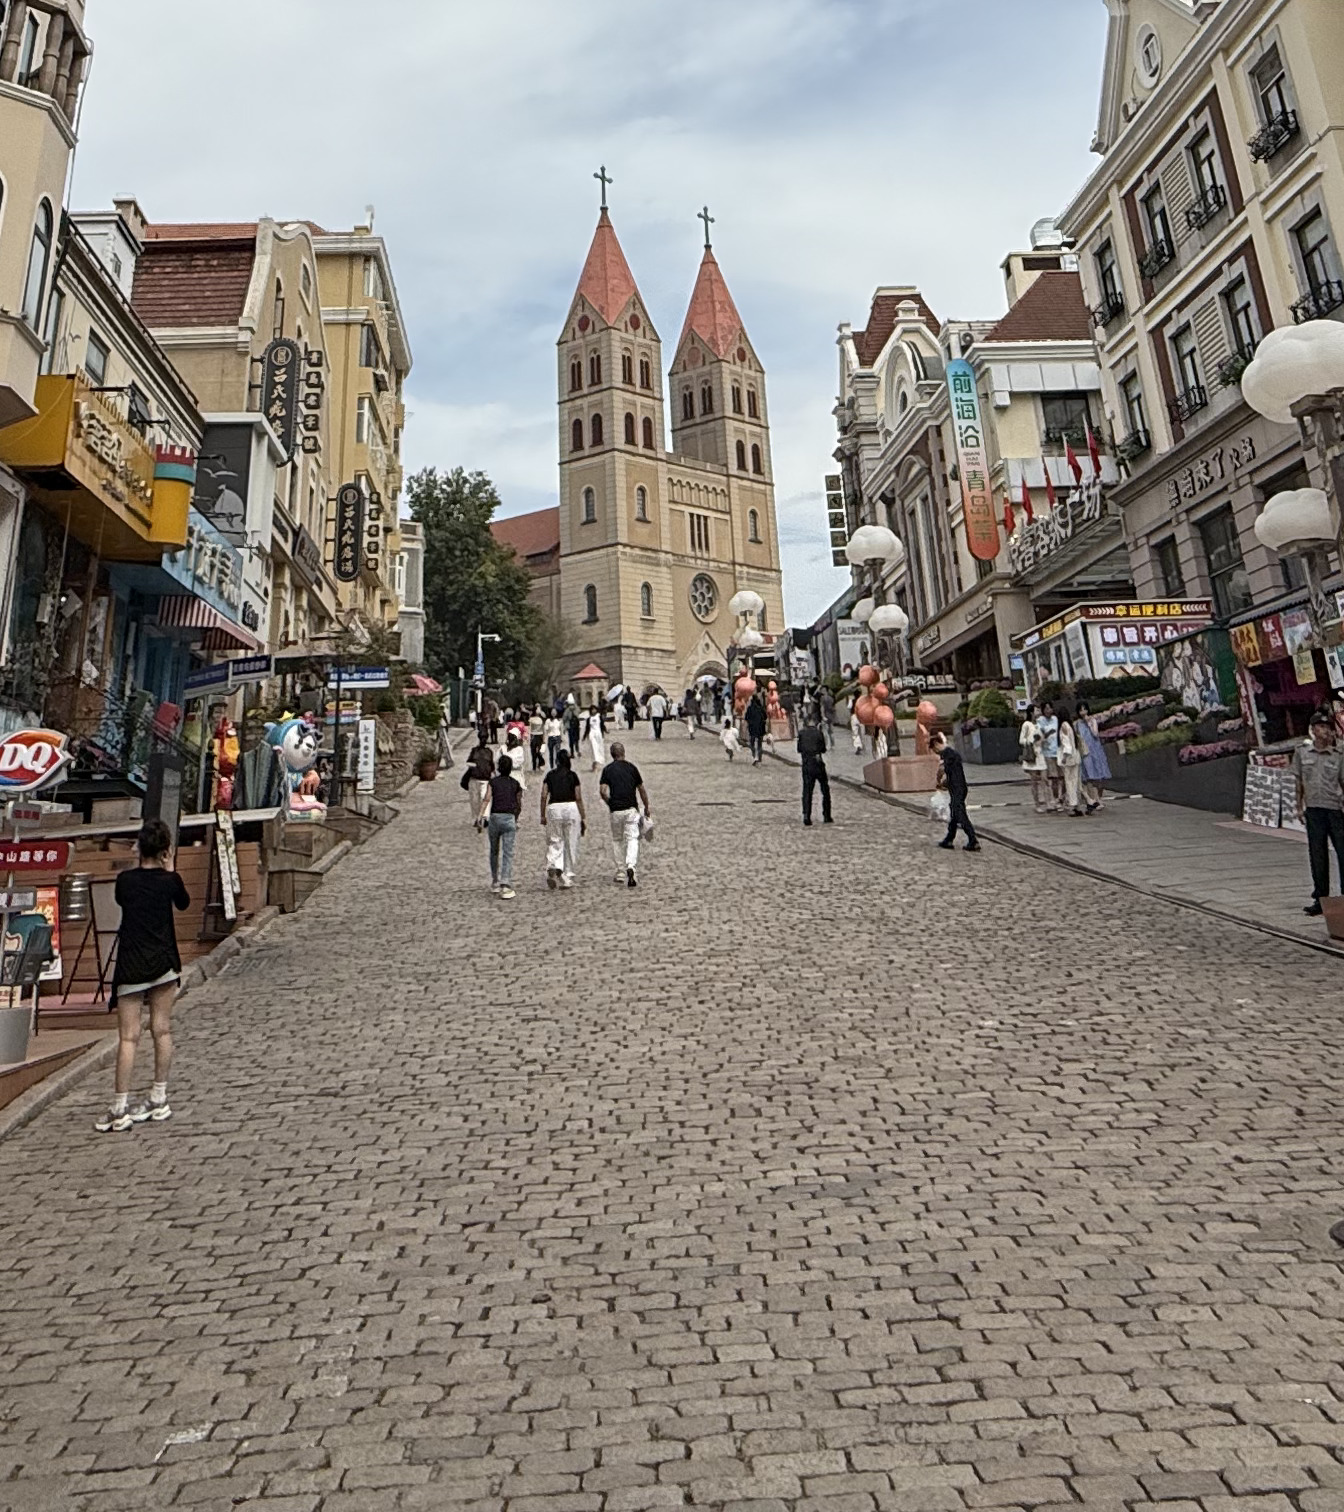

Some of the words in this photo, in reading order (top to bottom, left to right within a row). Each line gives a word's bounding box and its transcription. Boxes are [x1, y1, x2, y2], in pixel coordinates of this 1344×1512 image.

[269, 368, 287, 442] 吕氏疙瘩
[952, 370, 980, 449] 前海沿
